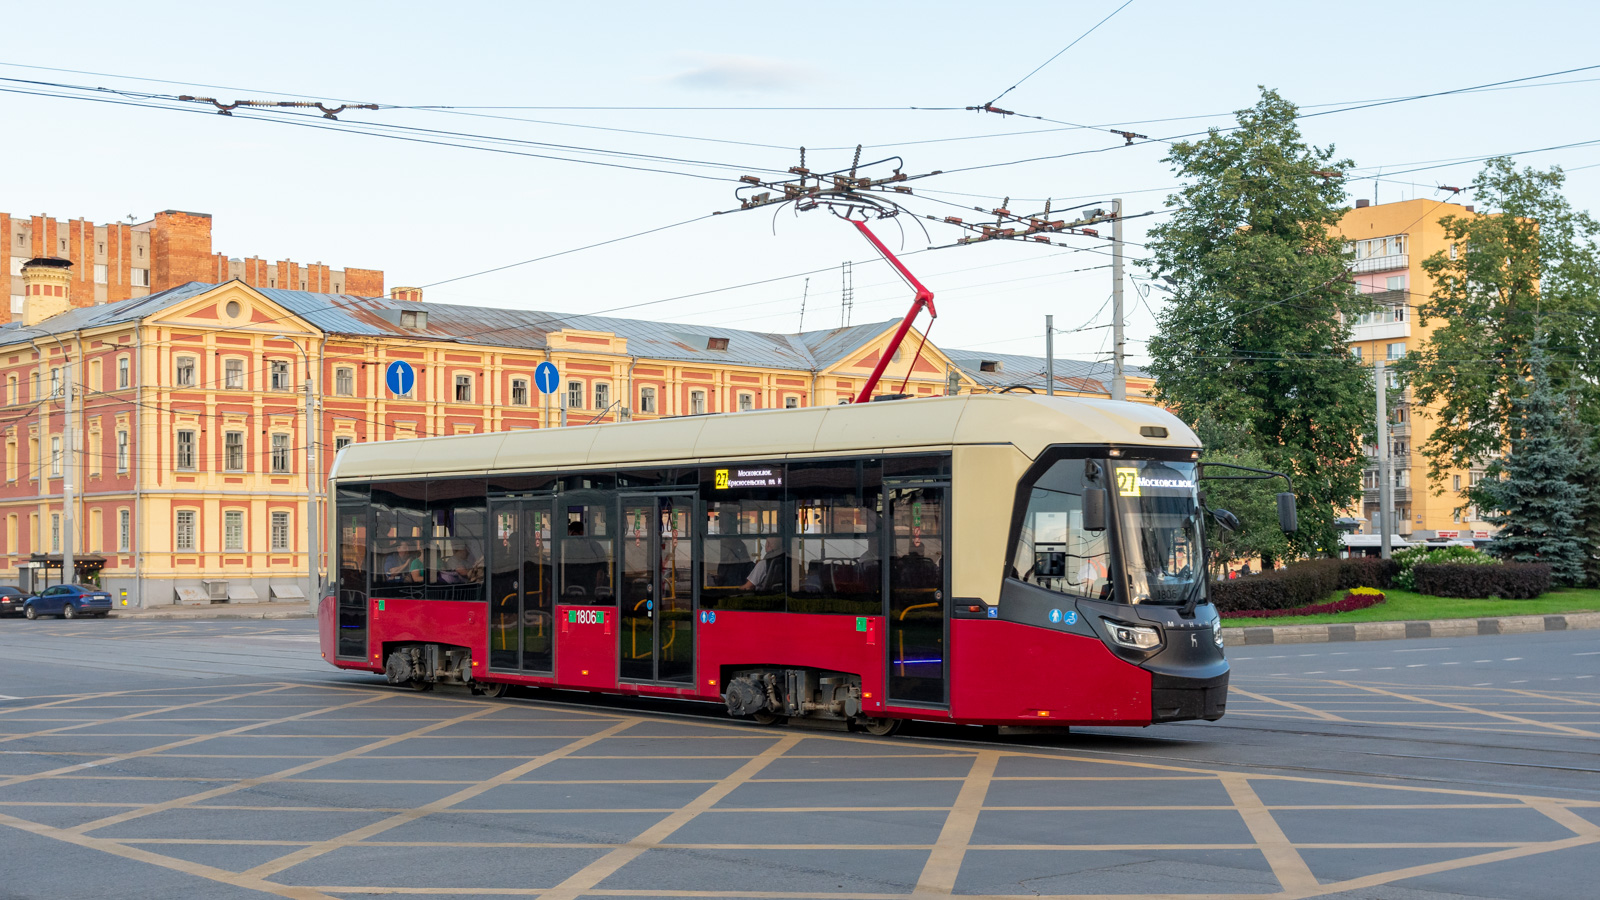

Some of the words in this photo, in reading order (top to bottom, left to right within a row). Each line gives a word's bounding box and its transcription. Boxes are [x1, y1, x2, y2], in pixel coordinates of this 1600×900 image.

[716, 473, 727, 487] 27
[1117, 472, 1136, 493] 27
[576, 610, 597, 624] 1806
